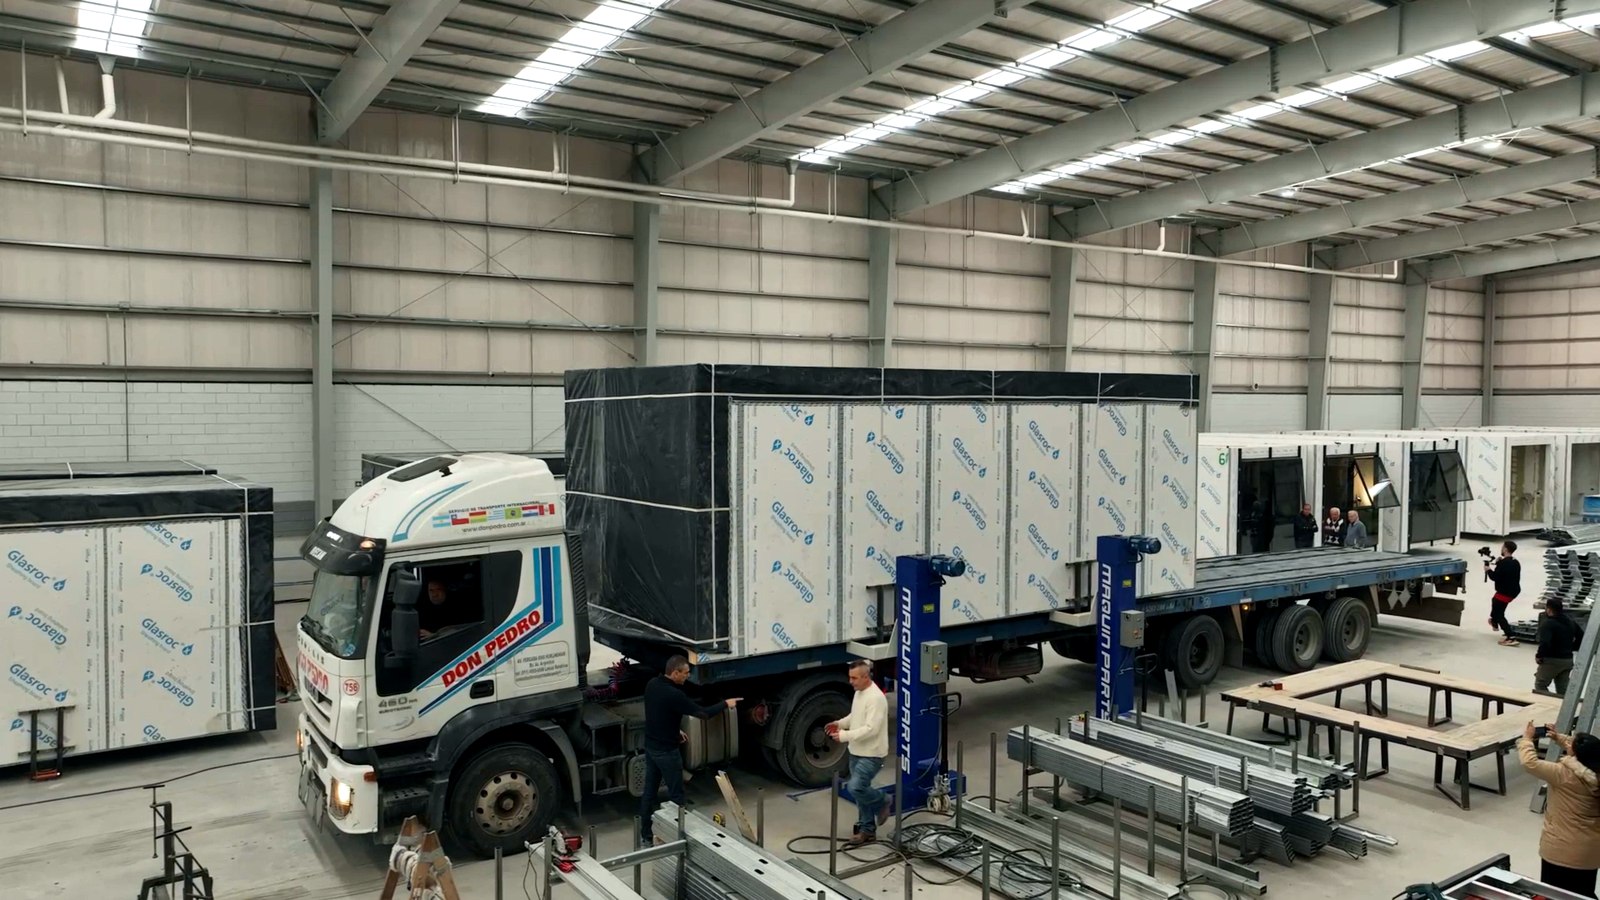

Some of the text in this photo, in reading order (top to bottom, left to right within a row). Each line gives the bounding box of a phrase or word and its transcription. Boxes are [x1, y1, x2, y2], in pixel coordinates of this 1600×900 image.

[1029, 421, 1051, 452] Glasroc
[1163, 429, 1181, 457] Glasroc
[784, 448, 814, 484] Glasroc
[877, 440, 903, 474] Glasroc
[953, 437, 977, 470] Glasroc
[1099, 449, 1118, 479] Glasroc
[866, 490, 893, 524] Glasroc
[1037, 478, 1059, 509] Glasroc
[772, 501, 802, 537] Glasroc
[962, 498, 986, 530] Glasroc
[1106, 504, 1125, 532] Glasroc
[1028, 523, 1050, 554] Glasroc
[8, 550, 50, 583] Glasroc
[952, 546, 977, 577] Glroc
[156, 571, 192, 602] Glasroc
[784, 568, 814, 603] Glasroc
[25, 615, 67, 646] Glasroc
[142, 618, 179, 650] Glasroc
[772, 623, 798, 649] Glasro
[1101, 563, 1111, 720] MAQUIN PARTS
[442, 610, 540, 687] DON PEDRO
[10, 664, 52, 696] Glasroc
[157, 677, 194, 707] Glasroc
[345, 682, 358, 691] 756
[902, 587, 911, 775] MAQUIN PARTS
